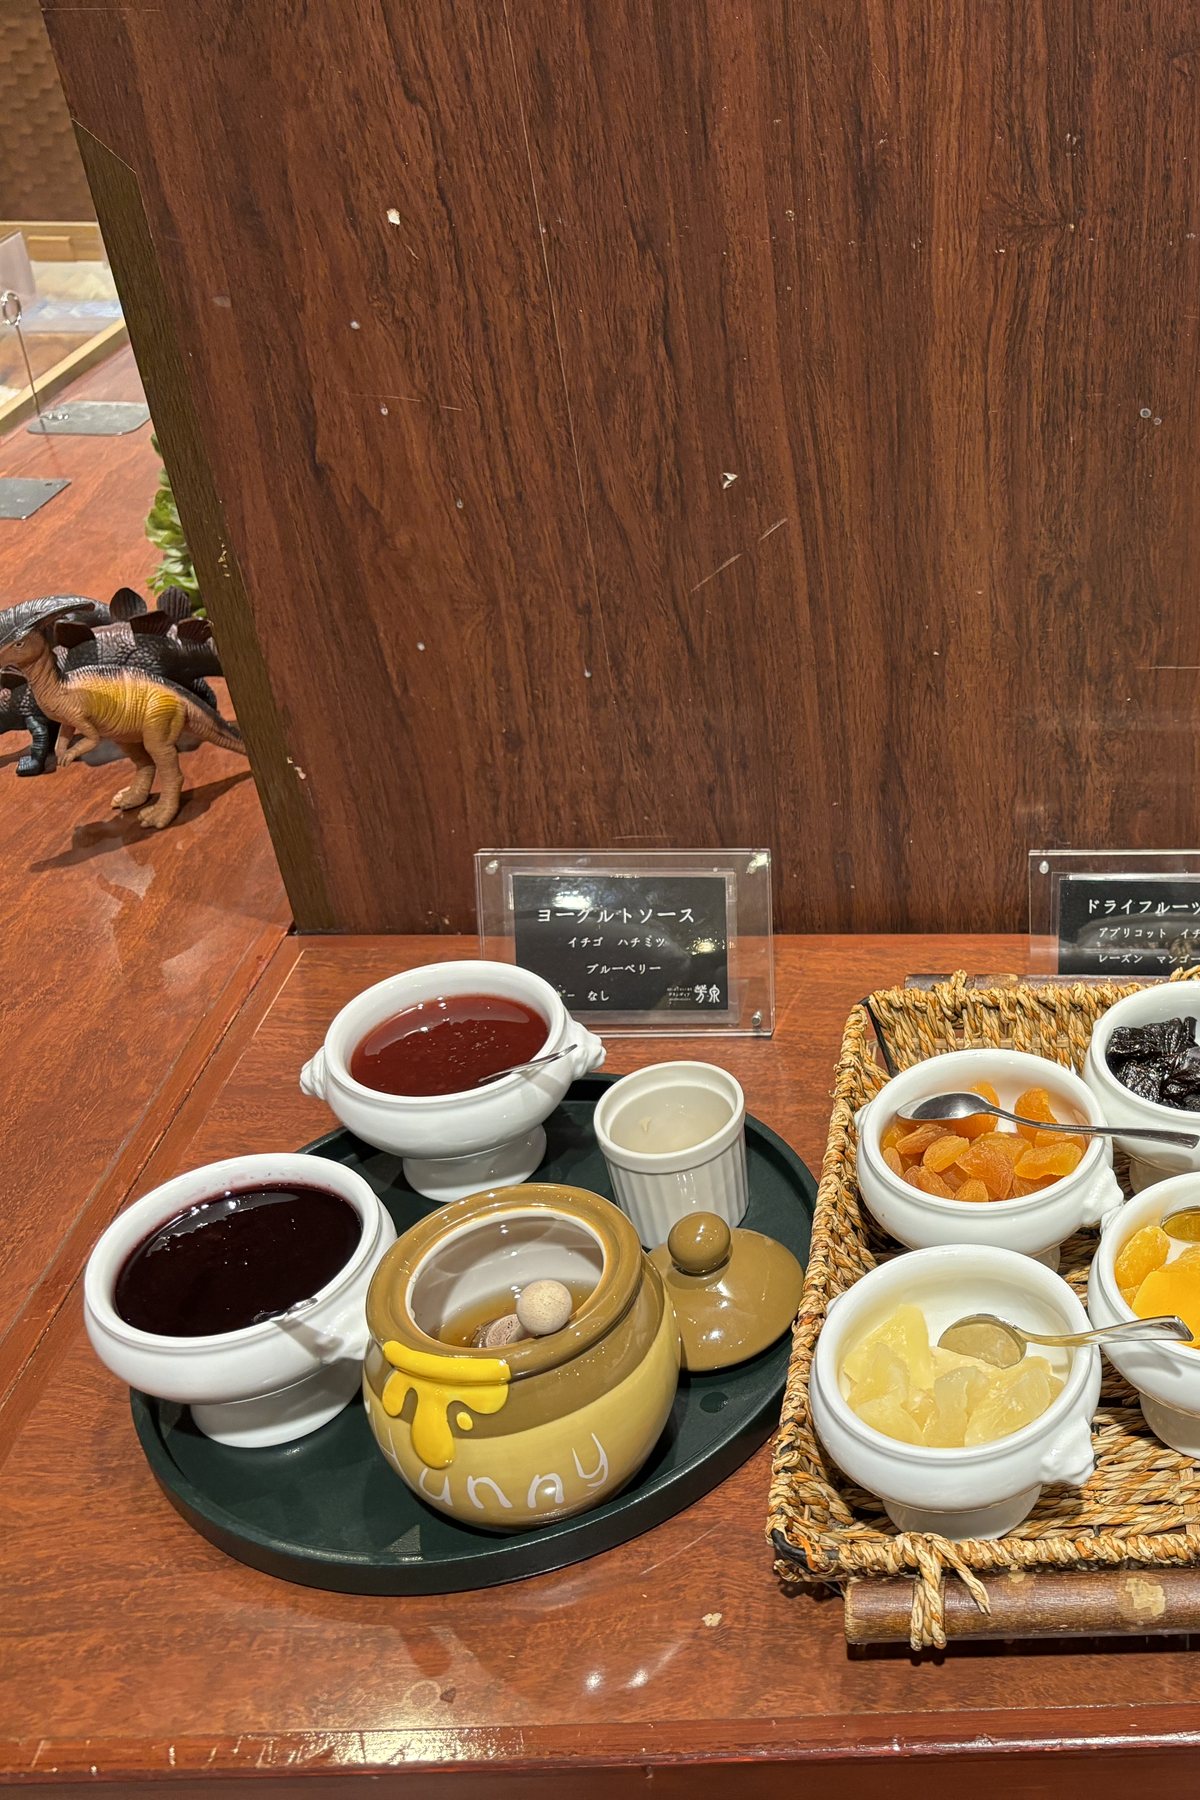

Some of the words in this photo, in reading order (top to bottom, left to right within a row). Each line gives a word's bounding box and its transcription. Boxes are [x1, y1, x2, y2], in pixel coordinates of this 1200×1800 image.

[537, 907, 695, 924] ヨーグルトソース
[1099, 927, 1166, 938] アプリコット
[568, 937, 604, 948] イチゴ
[617, 935, 665, 948] ハチミツ
[1098, 953, 1143, 964] レーズン
[586, 963, 662, 975] ブルーベリー
[587, 989, 610, 1002] なし
